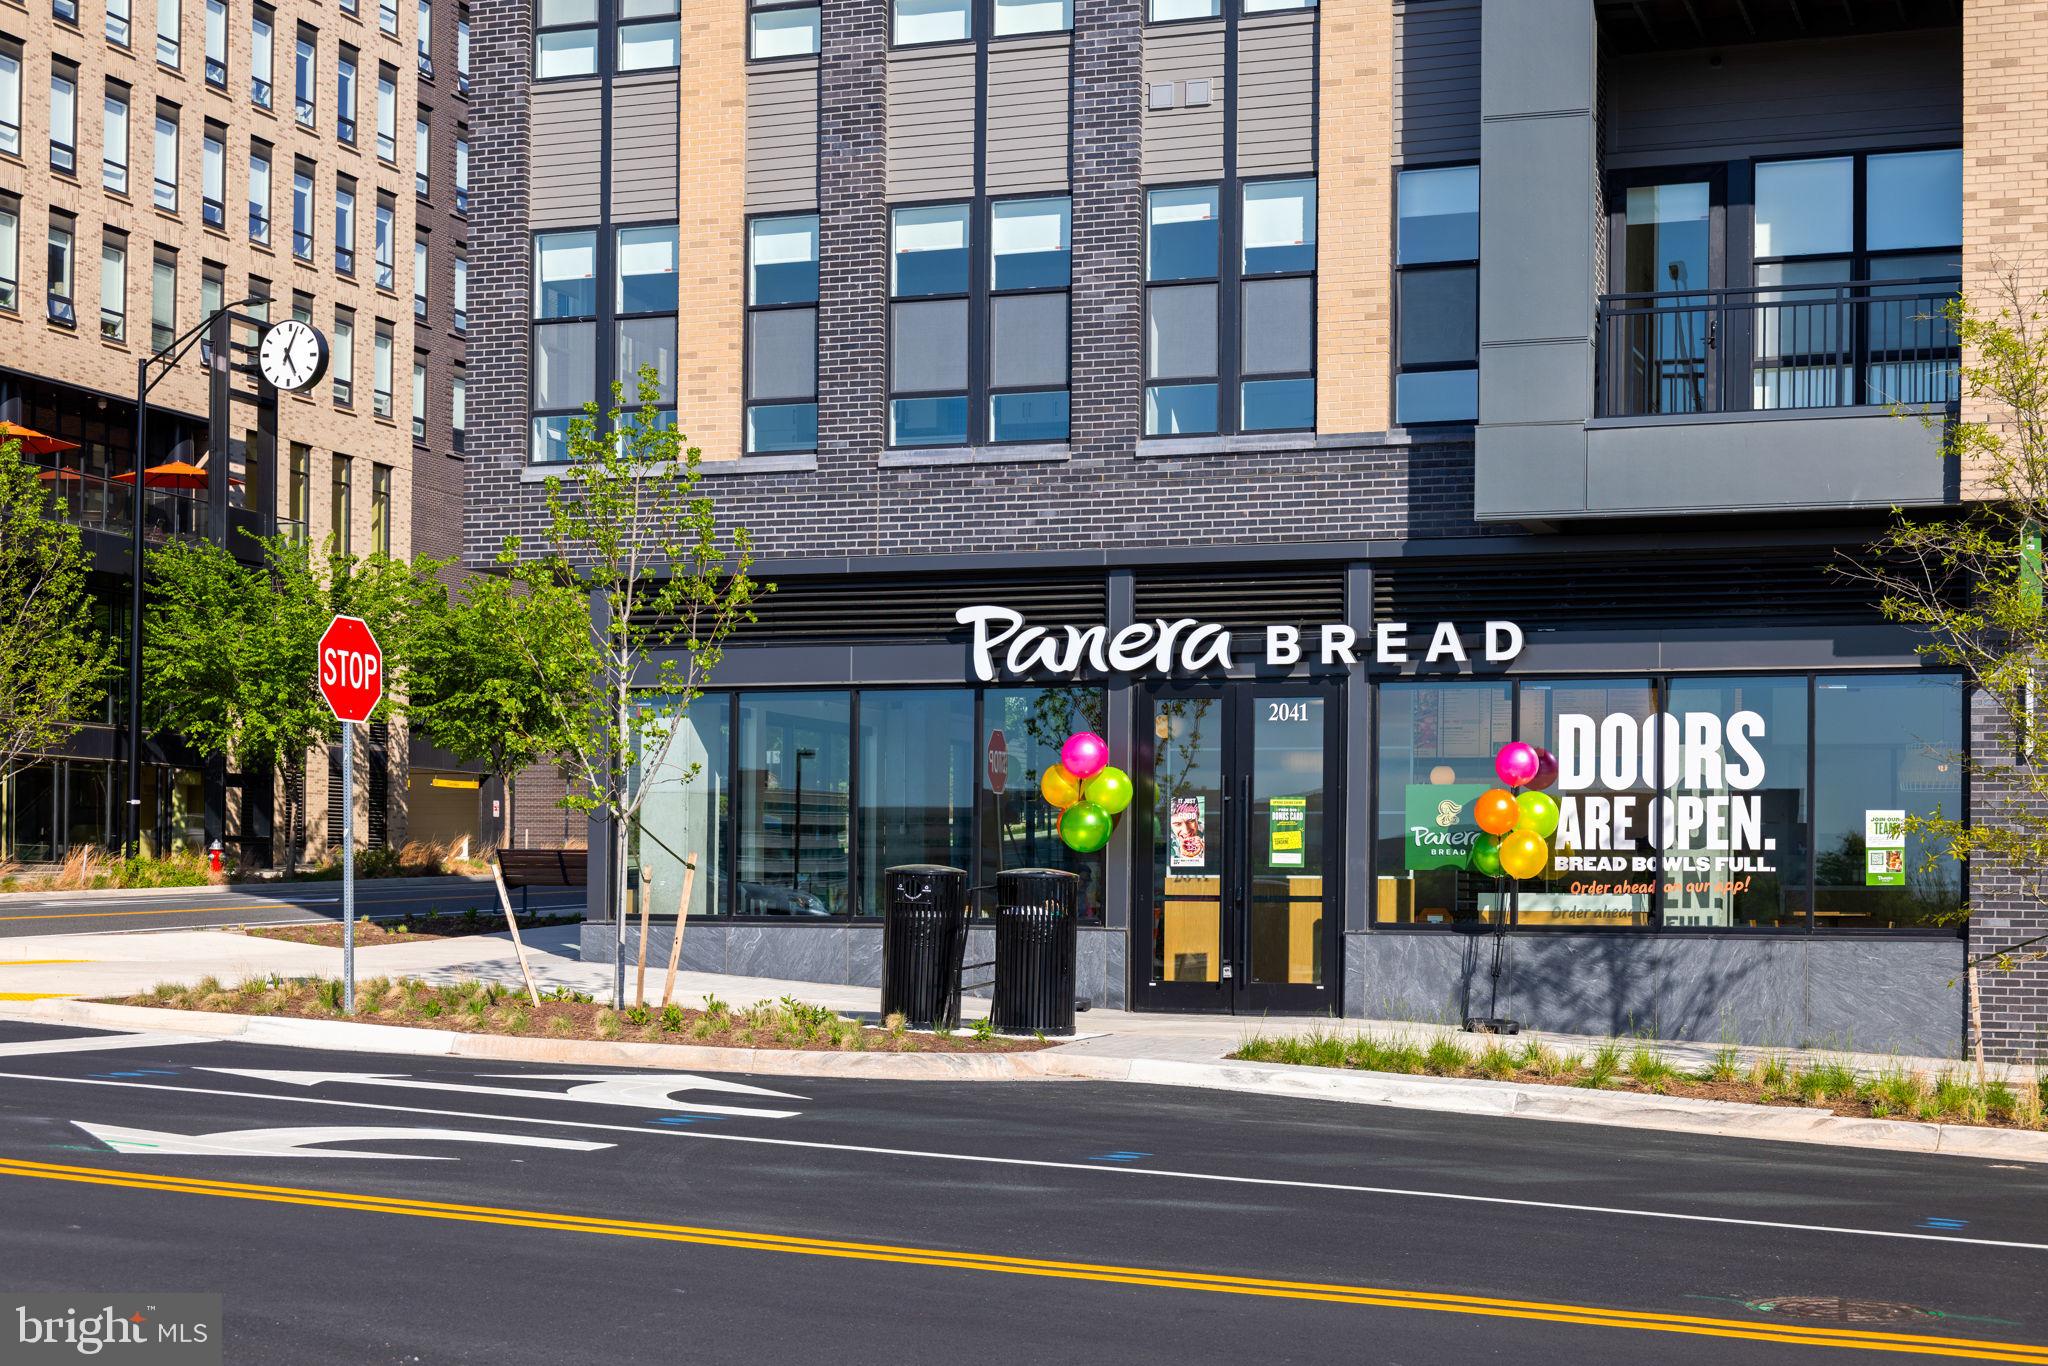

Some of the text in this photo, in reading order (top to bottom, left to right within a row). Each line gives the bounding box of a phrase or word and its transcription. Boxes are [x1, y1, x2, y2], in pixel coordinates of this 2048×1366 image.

[956, 605, 1525, 682] Panera BREAD
[323, 647, 378, 690] STOP
[1268, 702, 1309, 721] 2041
[1558, 711, 1766, 790] DOORS
[1179, 812, 1196, 820] GOOD
[1272, 811, 1304, 821] BONUS CARD
[1555, 795, 1776, 850] ARE OPEN.
[1430, 848, 1466, 856] BREAD
[1554, 856, 1776, 872] BREAD BOWLS FULL.
[1570, 880, 1611, 896] Order
[1613, 879, 1656, 894] ahead
[1663, 882, 1682, 893] on
[1685, 881, 1711, 893] our
